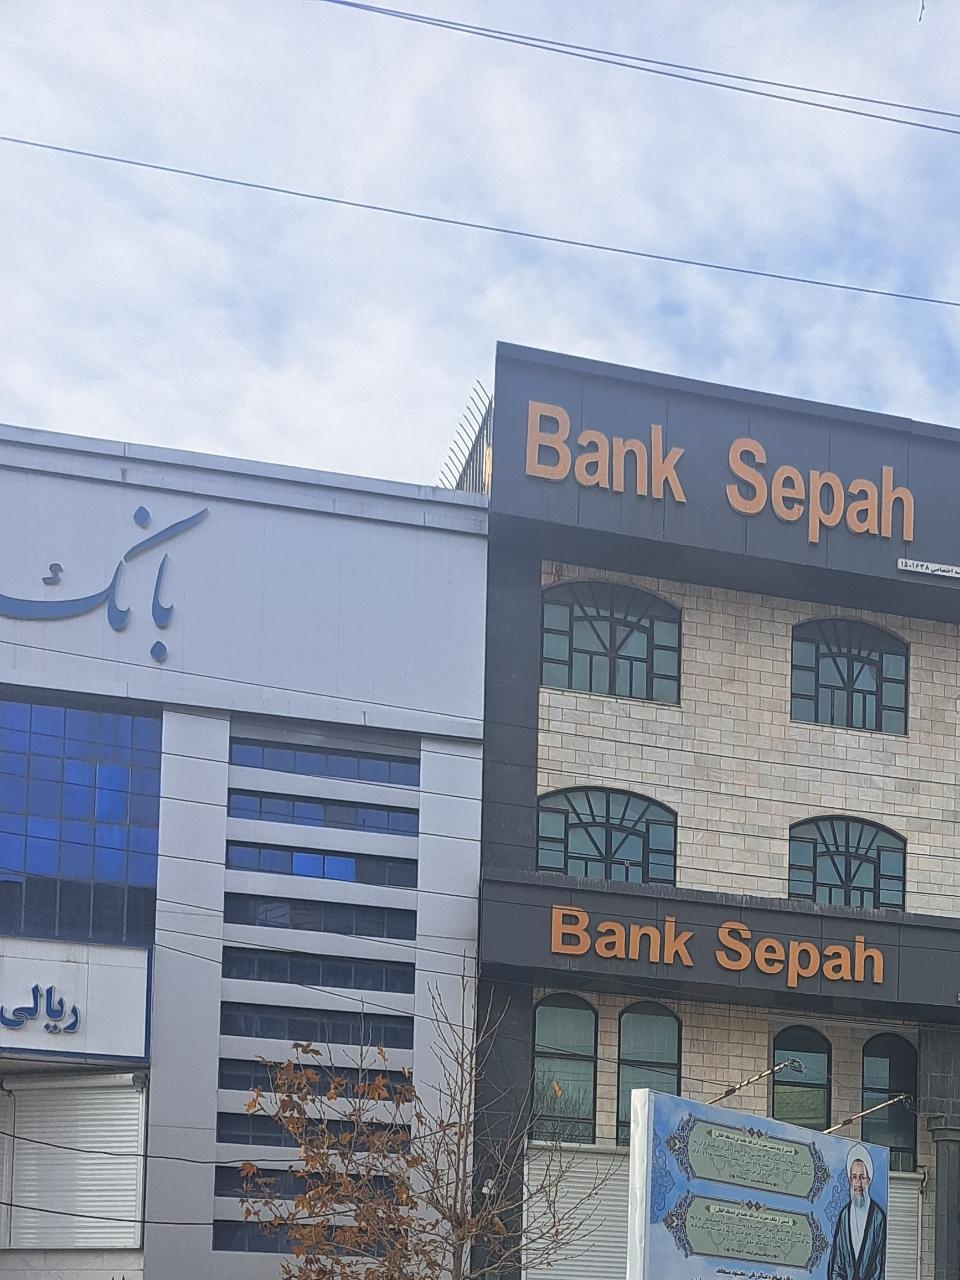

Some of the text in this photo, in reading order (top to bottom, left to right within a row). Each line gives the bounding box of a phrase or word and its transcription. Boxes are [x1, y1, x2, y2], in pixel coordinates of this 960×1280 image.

[525, 400, 915, 544] Bank Sepah
[550, 904, 886, 988] Bank Sepah
